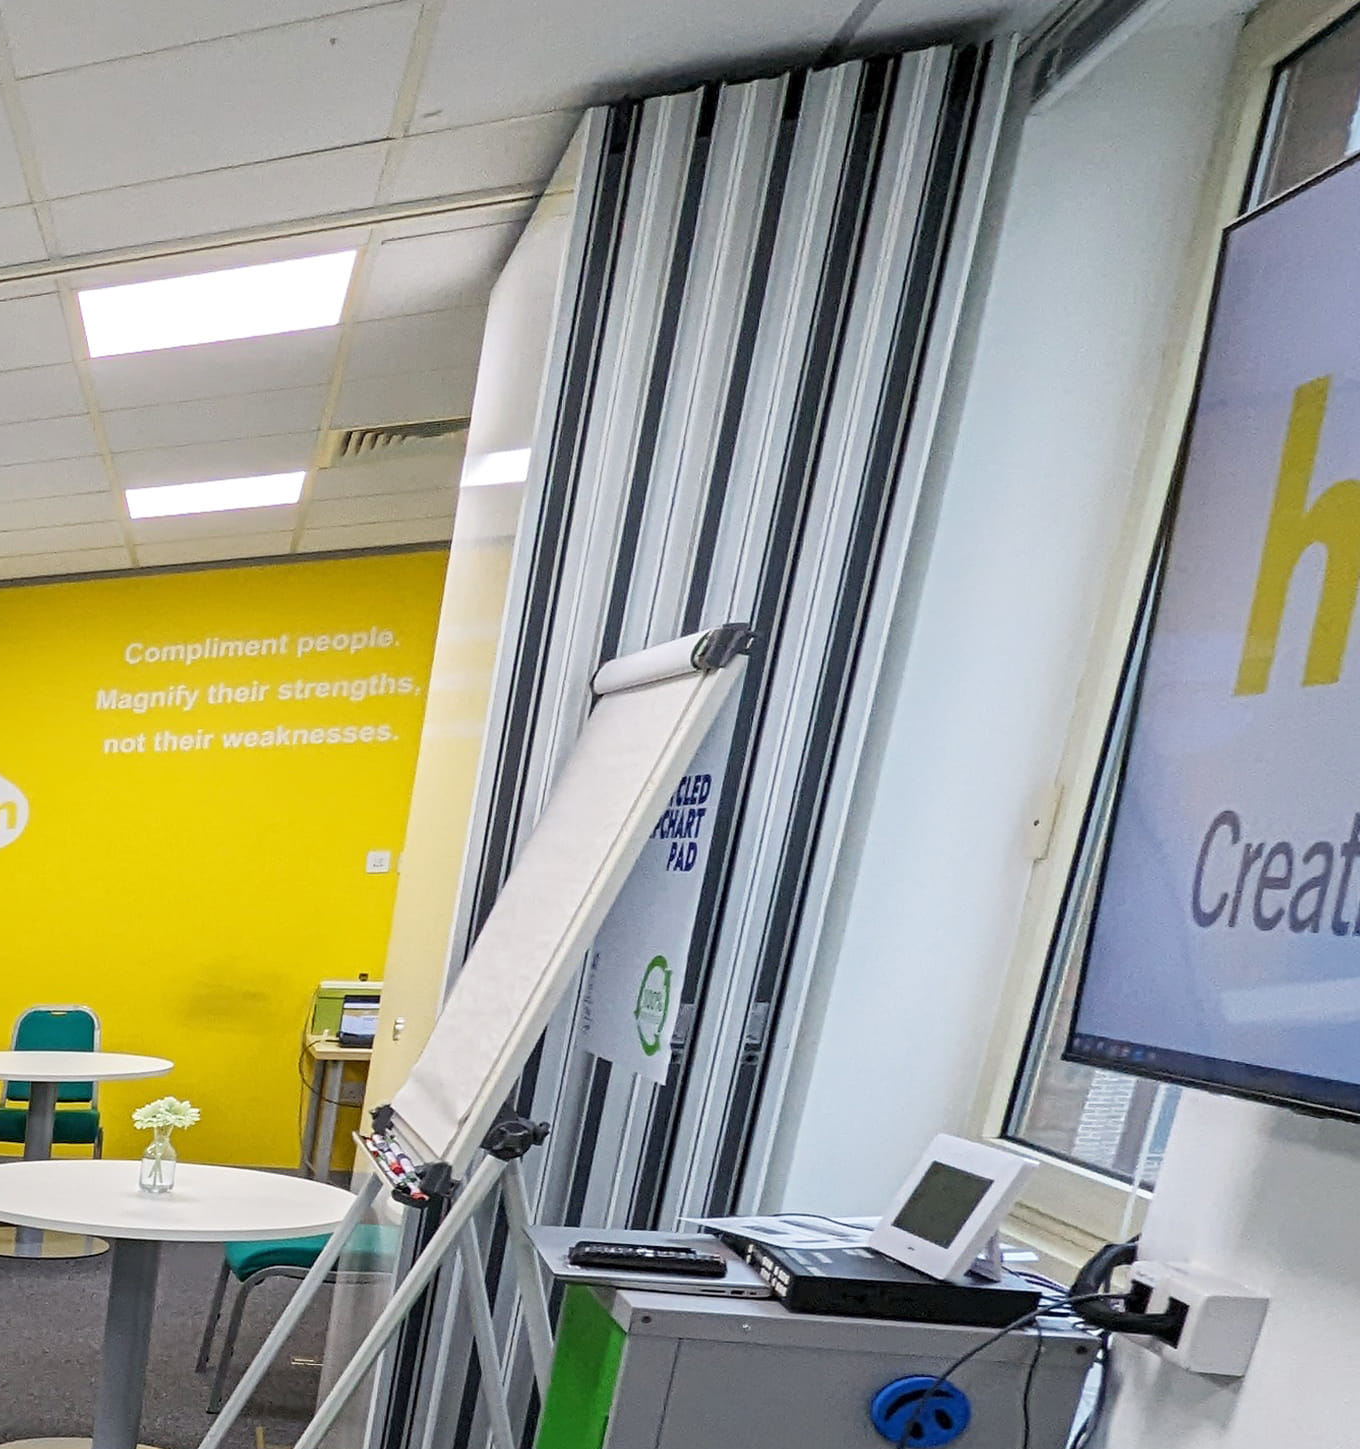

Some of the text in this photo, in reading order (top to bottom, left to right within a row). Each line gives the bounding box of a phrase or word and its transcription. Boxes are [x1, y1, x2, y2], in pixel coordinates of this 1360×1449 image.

[123, 626, 400, 666] Compliment people.
[95, 684, 199, 713] Magnify
[206, 679, 270, 705] their
[102, 724, 399, 755] not their weaknesses.
[666, 842, 698, 872] PAD
[1192, 810, 1360, 936] Creat
